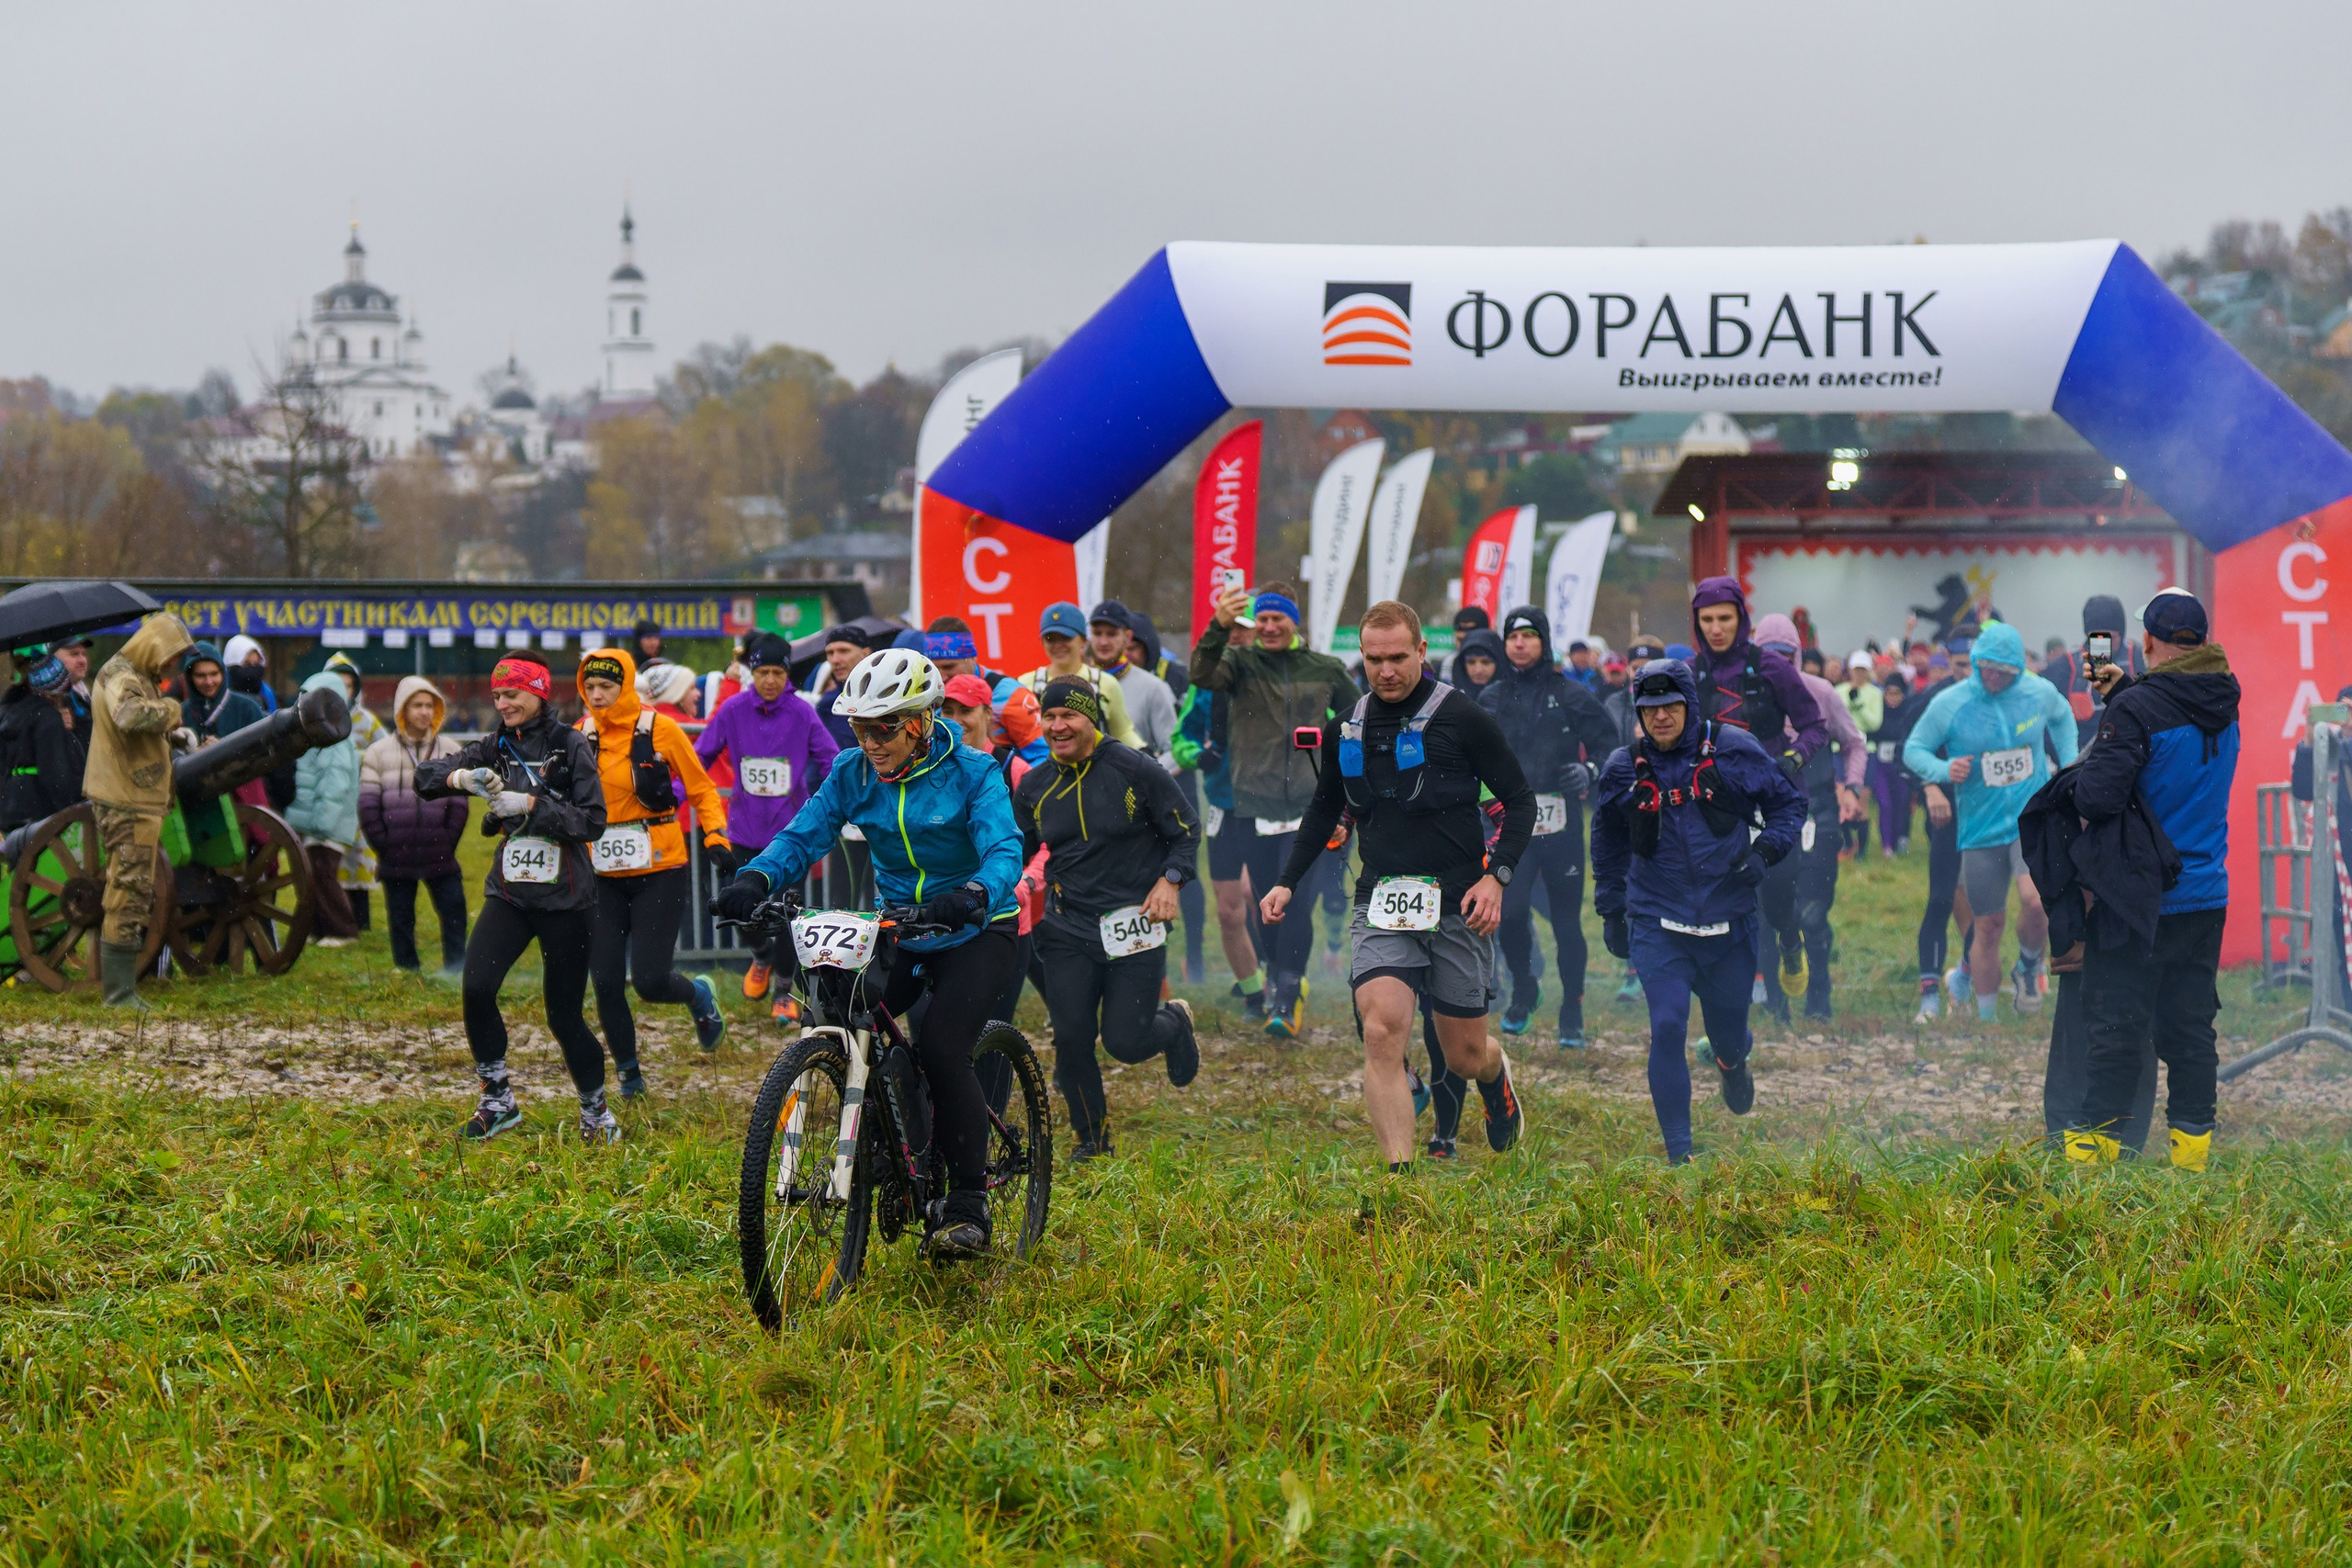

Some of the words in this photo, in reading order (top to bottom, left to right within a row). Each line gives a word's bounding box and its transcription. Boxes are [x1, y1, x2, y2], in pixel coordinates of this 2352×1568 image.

[1446, 289, 1942, 358] ФОРАБАНК
[1618, 367, 1810, 392] Выигрываем
[1818, 367, 1944, 388] вместе!
[232, 599, 461, 634] УЧАСТНИКАМ
[749, 768, 776, 784] 551
[1994, 757, 2024, 775] 555
[510, 849, 545, 869] 544
[601, 839, 636, 858] 565
[1384, 892, 1424, 914] 564
[804, 925, 857, 950] 572
[1114, 916, 1151, 942] 540
[1021, 1054, 1043, 1092] RACE
